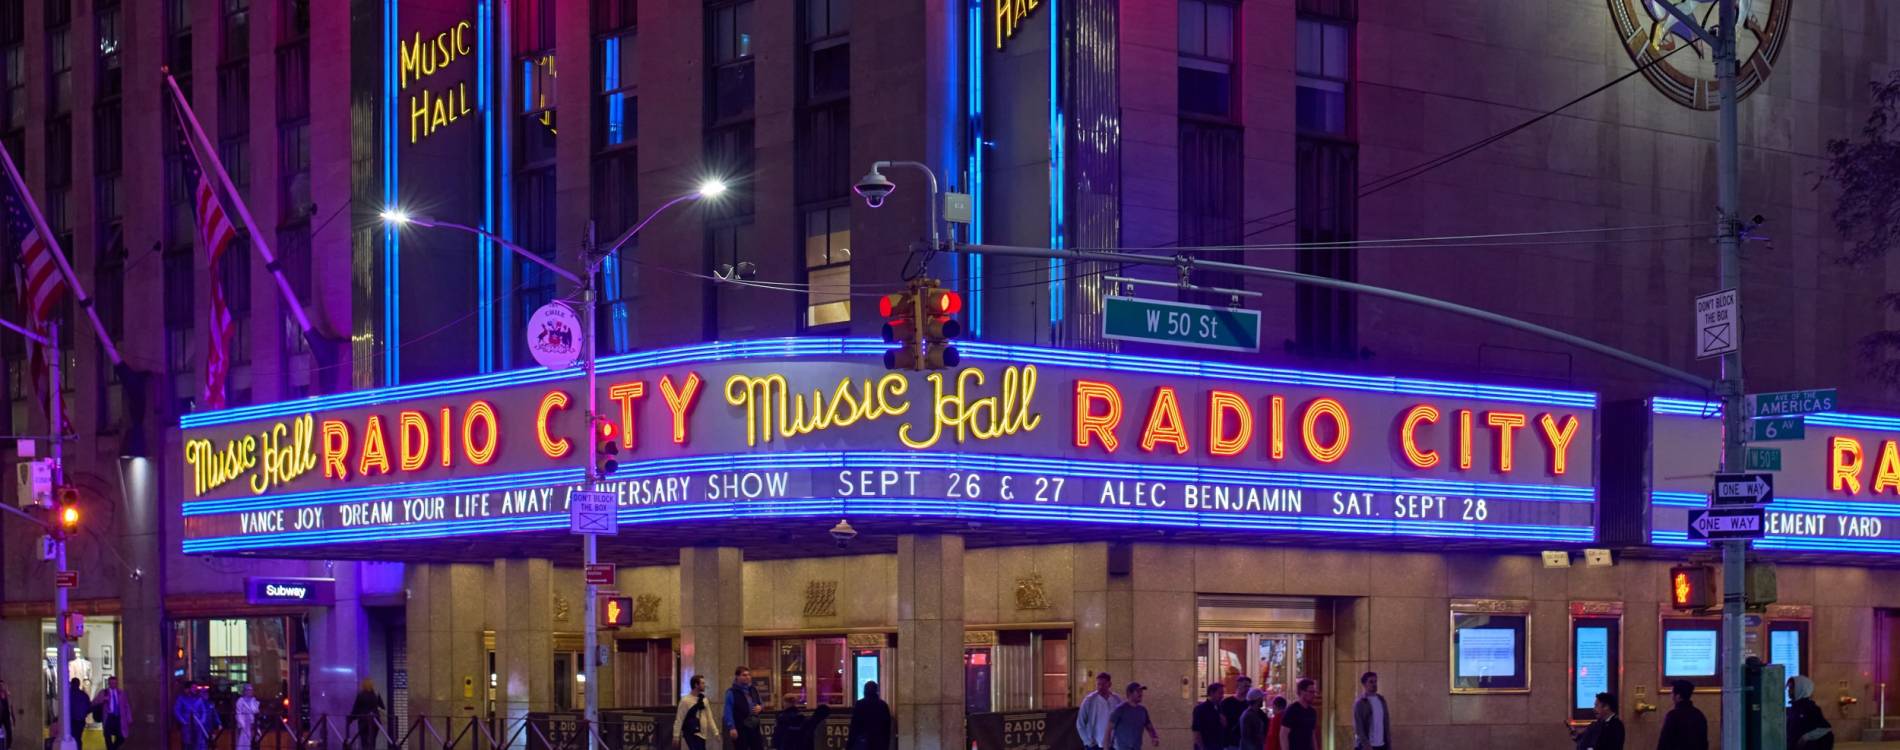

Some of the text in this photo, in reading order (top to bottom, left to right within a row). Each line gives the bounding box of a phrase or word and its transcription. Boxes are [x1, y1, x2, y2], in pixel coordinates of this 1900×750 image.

[994, 0, 1039, 49] HA
[401, 21, 470, 89] MUSIC
[411, 82, 471, 144] HALL
[1698, 295, 1734, 312] DON'T BLOCK
[545, 309, 565, 319] CHILE
[1705, 310, 1728, 325] THE BOX
[1146, 309, 1218, 339] W 50 St
[1775, 390, 1816, 401] AVE OF THE
[725, 364, 1041, 449] Music Hall
[1760, 398, 1832, 415] AMERICAS
[322, 370, 700, 480] RADIO CTY
[1075, 379, 1579, 475] RADIO CITY
[1765, 420, 1794, 438] 6 AV
[186, 412, 316, 497] Music Hall
[1760, 450, 1770, 468] 50
[1832, 436, 1900, 496] RA
[573, 493, 614, 503] DON'T BLOCK
[1723, 484, 1765, 496] ONE WAY
[240, 510, 285, 534] VANCE
[403, 496, 445, 521] YOUR
[455, 493, 491, 518] LIFE
[707, 472, 789, 500] SHOW
[838, 470, 921, 496] SEPT
[946, 473, 982, 499] 26
[1000, 476, 1015, 500] &
[1034, 478, 1065, 503] 27
[1100, 480, 1167, 508] ALEC
[1184, 484, 1302, 512] BENJAMIN
[1332, 491, 1381, 517] SAT.
[1394, 494, 1447, 519] SEPT
[1462, 498, 1488, 521] 28
[581, 503, 607, 512] THE BOX
[1700, 517, 1755, 530] ONE WAY
[1838, 514, 1882, 538] YARD
[266, 584, 306, 599] Subway
[549, 721, 577, 731] RDIO
[623, 721, 654, 732] RADIO
[826, 726, 850, 737] RAD
[1004, 720, 1046, 733] RADIO
[623, 732, 654, 743] CITY
[1004, 731, 1045, 744] CITY
